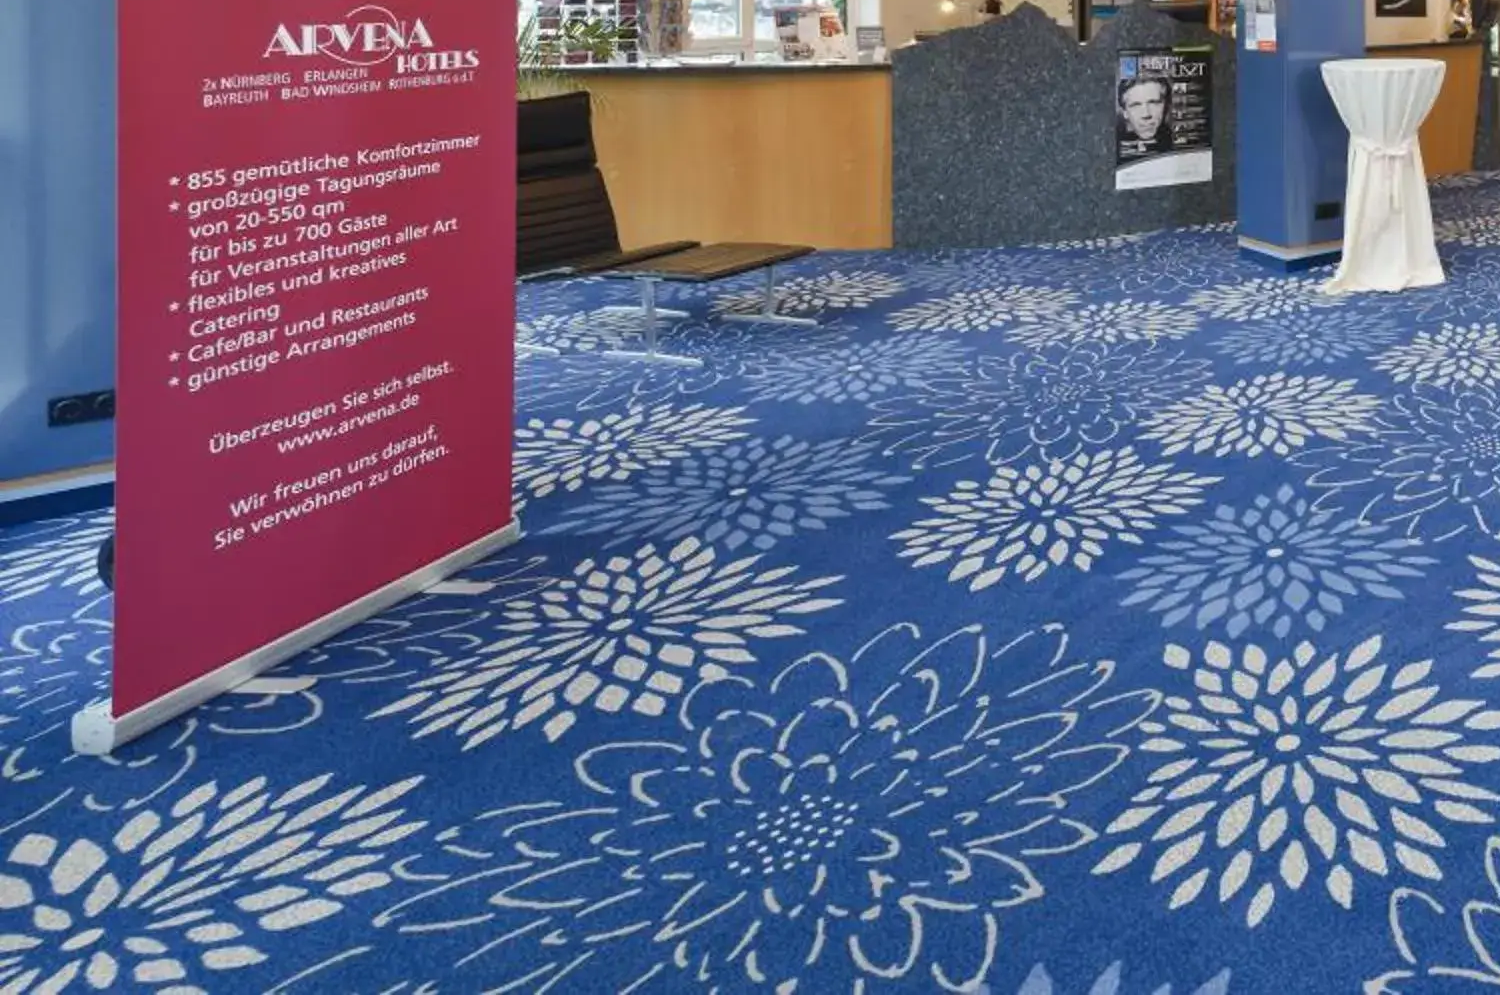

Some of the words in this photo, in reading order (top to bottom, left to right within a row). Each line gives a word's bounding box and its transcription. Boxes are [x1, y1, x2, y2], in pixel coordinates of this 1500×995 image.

[262, 16, 434, 58] ARVENA
[397, 49, 480, 74] HOTELS
[203, 89, 269, 108] BAYREUTH
[281, 86, 309, 100] BAD
[312, 80, 381, 98] WINDSHEIM
[388, 74, 451, 90] ROTHENBURG
[220, 72, 291, 89] NÜRNBERG
[303, 68, 368, 83] ERLANGEN
[187, 168, 226, 190] 855
[233, 153, 349, 187] gemütliche
[357, 135, 480, 165] Komfortzimmer
[187, 183, 310, 219] großzügige
[316, 161, 441, 194] Tagungsräume
[189, 220, 229, 240] von
[235, 203, 305, 231] 20-550
[312, 200, 345, 219] qm
[189, 245, 222, 264] für
[228, 237, 257, 256] bis
[263, 233, 287, 249] zu
[295, 222, 332, 242] 700
[338, 213, 388, 234] Gäste
[188, 269, 222, 288] für
[227, 234, 391, 280] Veranstaltungen
[395, 224, 429, 245] aller
[433, 218, 458, 235] Art
[188, 282, 276, 314] flexibles
[281, 268, 323, 292] und
[329, 252, 407, 281] kreatives
[187, 327, 278, 362] Cafe/Bar
[284, 312, 325, 336] und
[331, 286, 429, 326] Restaurants
[189, 304, 281, 337] Catering
[187, 350, 281, 392] günstige
[286, 311, 417, 359] Arrangements
[209, 402, 337, 454] Überzeugen
[342, 391, 369, 410] Sie
[373, 375, 402, 400] sich
[406, 361, 454, 387] selbst.
[277, 393, 420, 454] www.arvena.de
[214, 527, 245, 550] Sie
[250, 480, 363, 534] verwöhnen
[368, 469, 389, 488] zu
[392, 445, 449, 476] dürfen.
[230, 493, 268, 518] Wir
[274, 467, 342, 502] freuen
[347, 452, 379, 474] uns
[382, 424, 438, 460] darauf,
